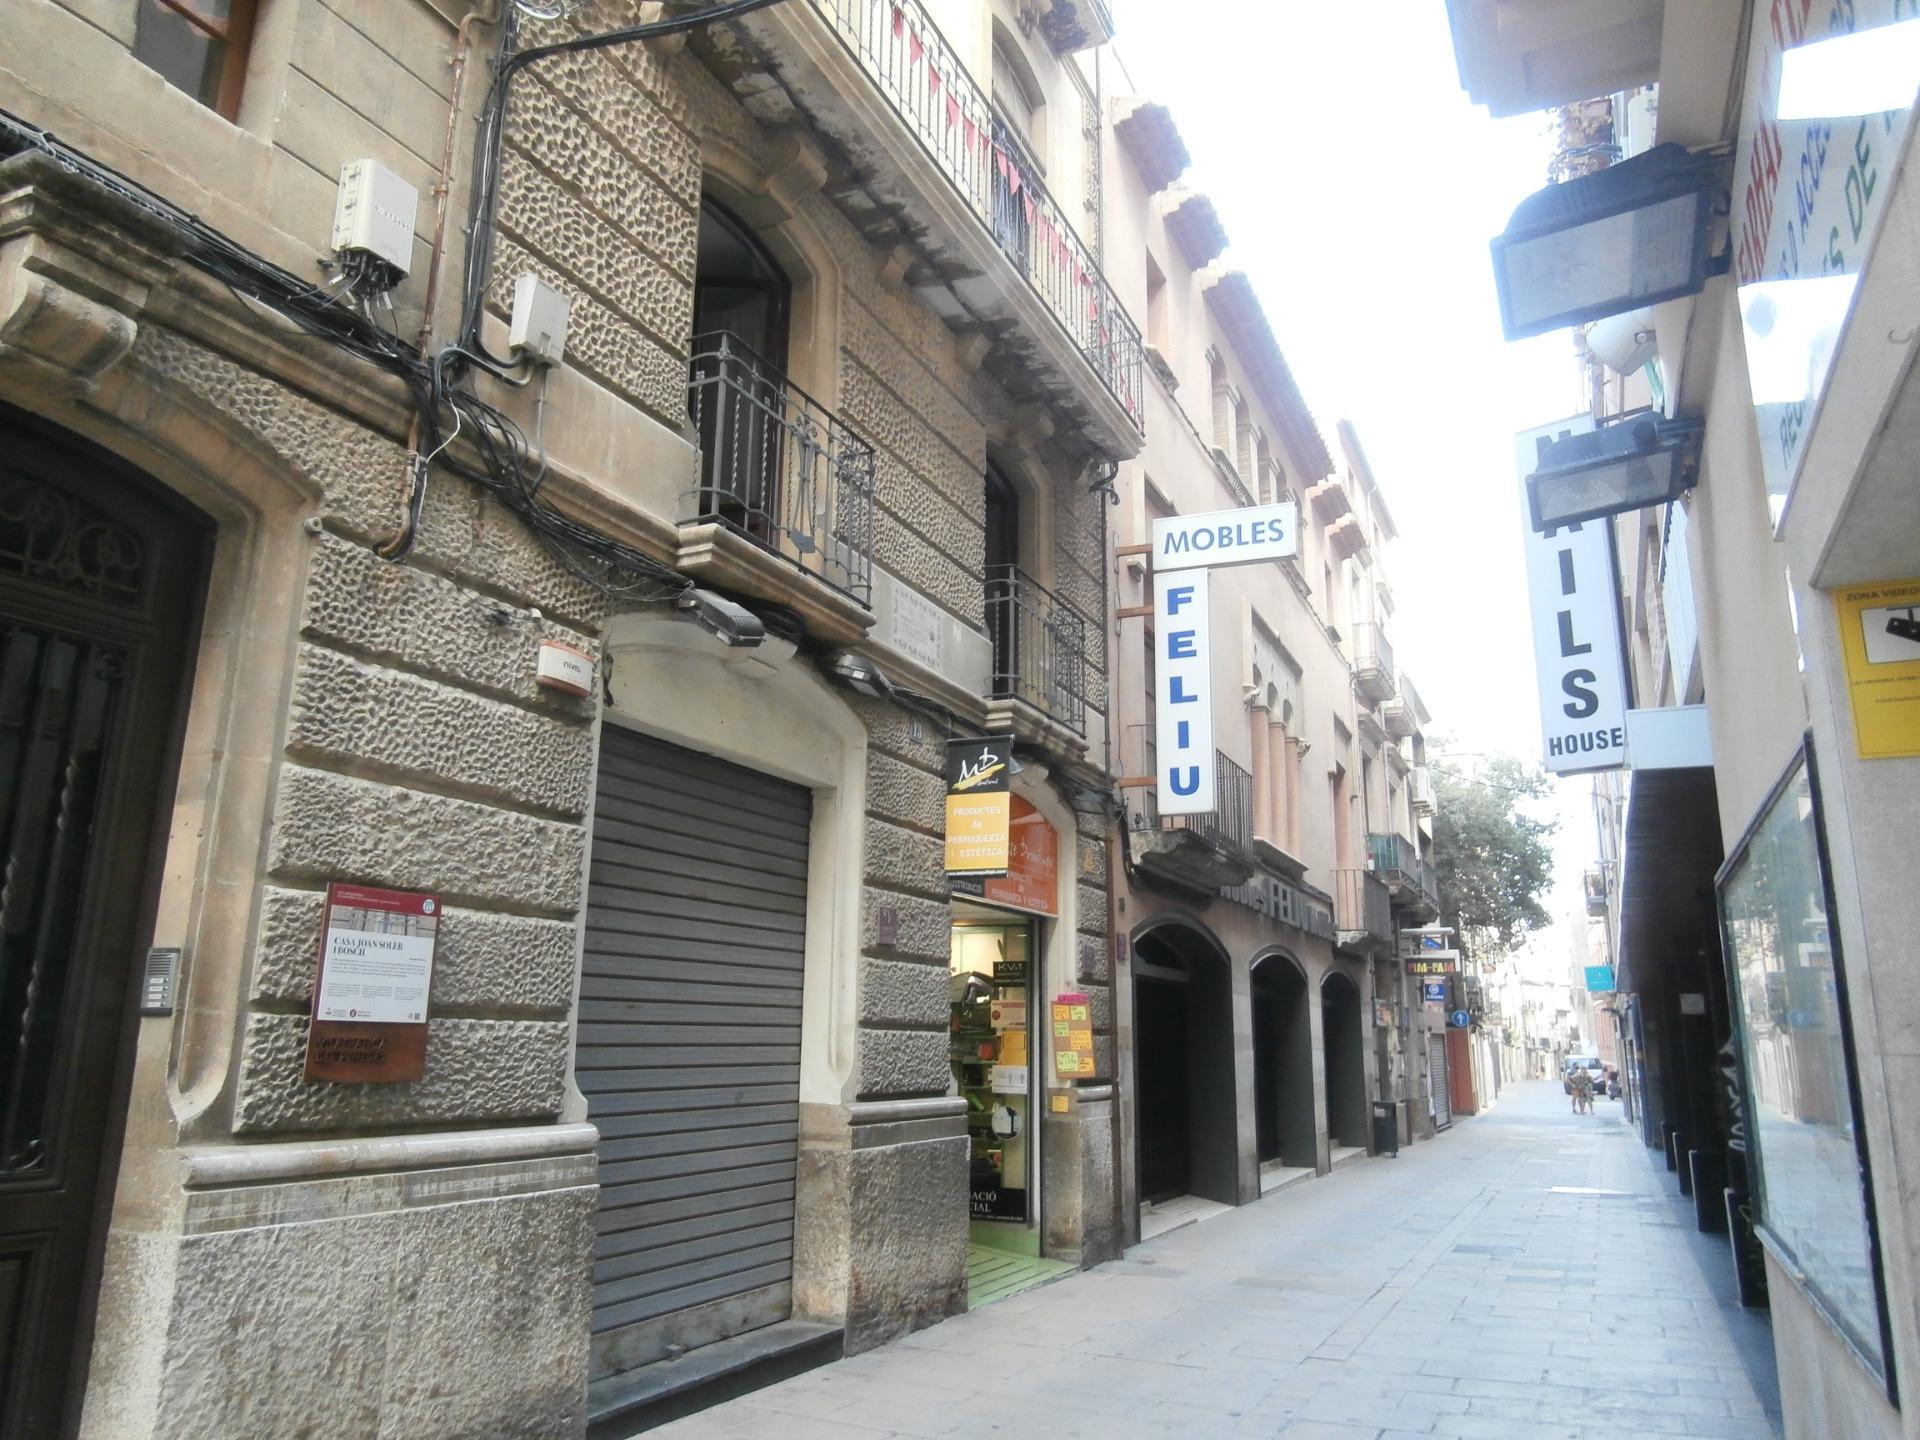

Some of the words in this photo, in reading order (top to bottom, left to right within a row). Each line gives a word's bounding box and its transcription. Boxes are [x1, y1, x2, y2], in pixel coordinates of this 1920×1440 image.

[1163, 518, 1285, 555] MOBLES
[1535, 429, 1600, 720] ILS
[1846, 592, 1880, 601] ZONA
[1167, 584, 1201, 796] FELIU
[1549, 727, 1624, 757] HOUSE
[953, 806, 1001, 816] PRODUCTES
[333, 937, 356, 948] CASA
[356, 938, 377, 952] JOAN
[379, 942, 404, 951] SOLER
[338, 947, 366, 957] BOSCH
